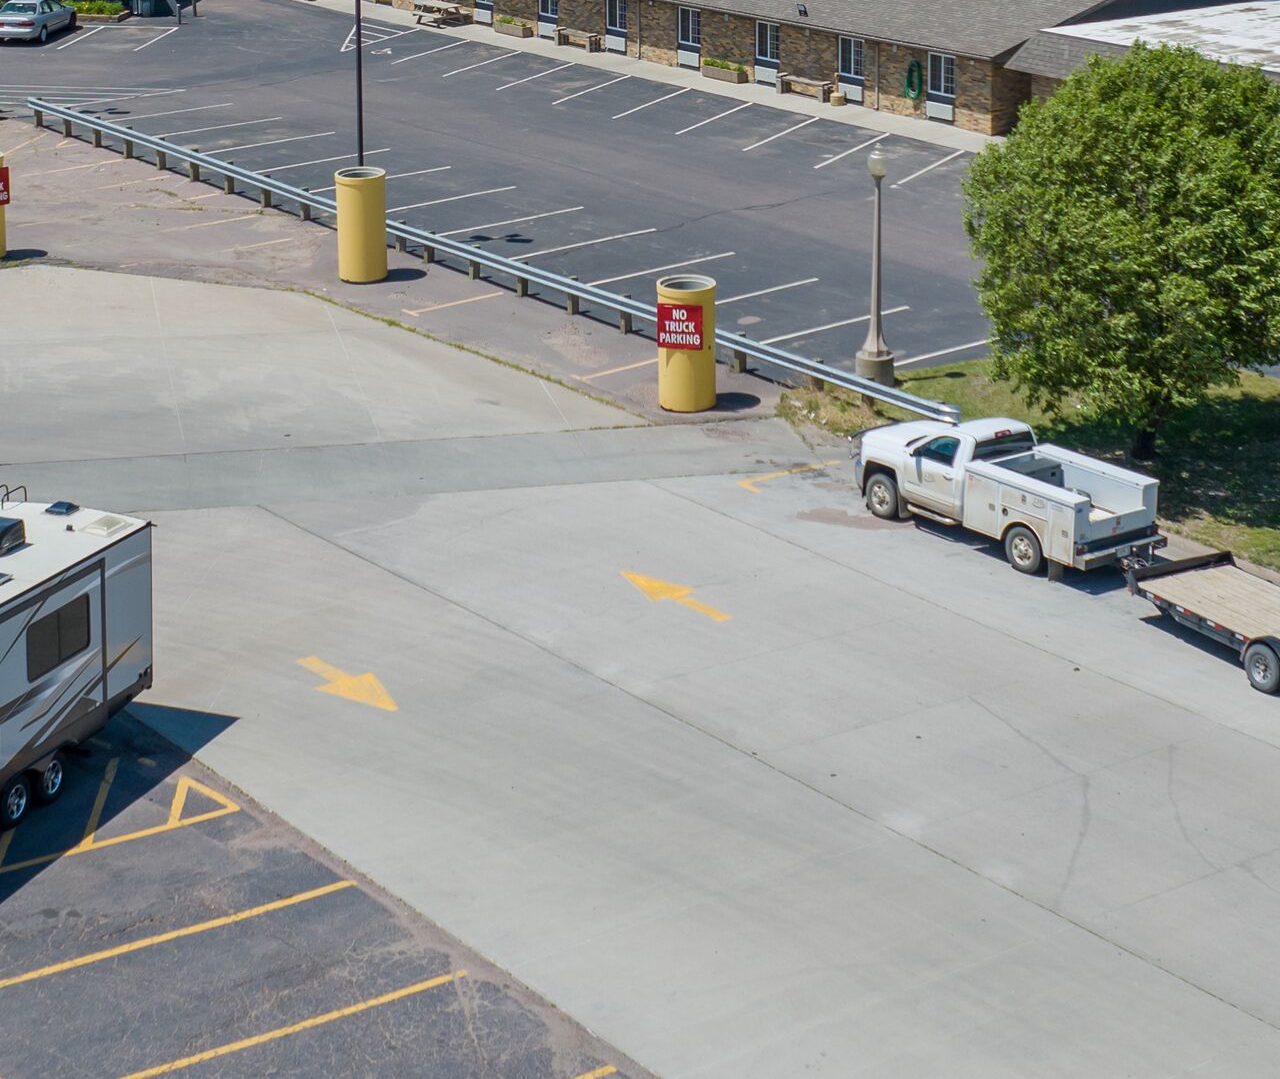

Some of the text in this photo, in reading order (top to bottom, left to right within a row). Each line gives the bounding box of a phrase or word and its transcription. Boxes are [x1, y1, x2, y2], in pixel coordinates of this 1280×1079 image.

[672, 309, 687, 321] NO
[665, 321, 695, 333] TRUCK
[659, 332, 701, 345] PARKING
